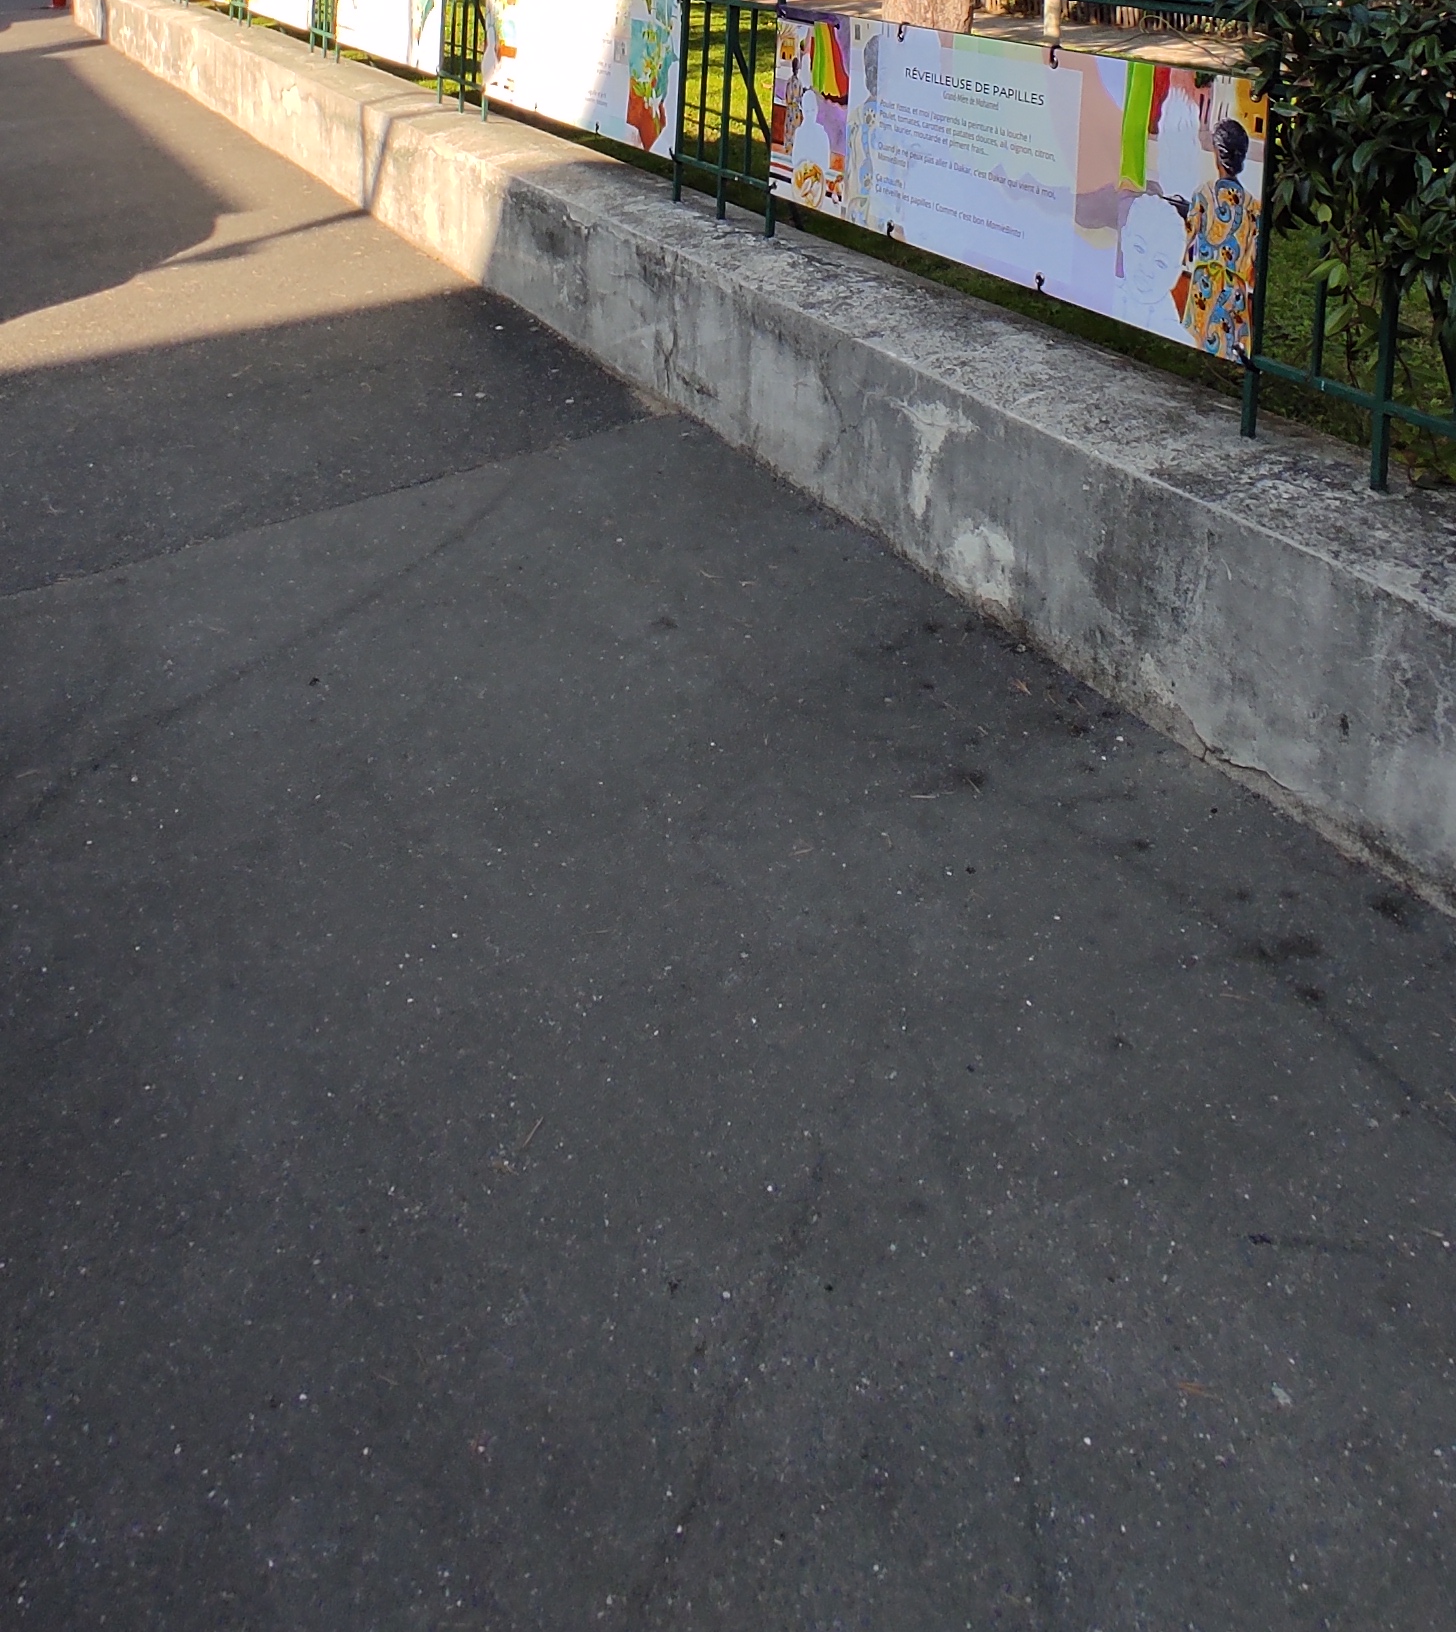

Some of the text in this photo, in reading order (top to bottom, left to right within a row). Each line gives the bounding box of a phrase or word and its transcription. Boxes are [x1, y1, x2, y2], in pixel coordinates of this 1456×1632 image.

[905, 67, 1045, 106] RÉVEILLEUSE DE PAPILLES
[880, 99, 895, 109] Poulet
[919, 110, 930, 118] moi
[930, 111, 960, 126] j'apprends
[968, 122, 993, 134] peinture
[1007, 129, 1027, 141] louche
[922, 122, 945, 133] carottes
[953, 130, 974, 141] patates
[914, 131, 941, 144] moutarde
[949, 140, 970, 151] piment
[878, 141, 895, 153] Quand
[909, 152, 923, 160] peux
[924, 156, 934, 164] pas
[935, 158, 948, 168] aller
[973, 169, 987, 179] c'est
[988, 172, 1006, 184] Dakar
[1007, 179, 1018, 188] qui
[1019, 182, 1034, 193] vient
[883, 187, 901, 199] réveille
[902, 192, 910, 202] les
[910, 197, 931, 209] papilles
[935, 203, 958, 217] Comme
[959, 211, 972, 222] c'est
[973, 215, 985, 225] bon
